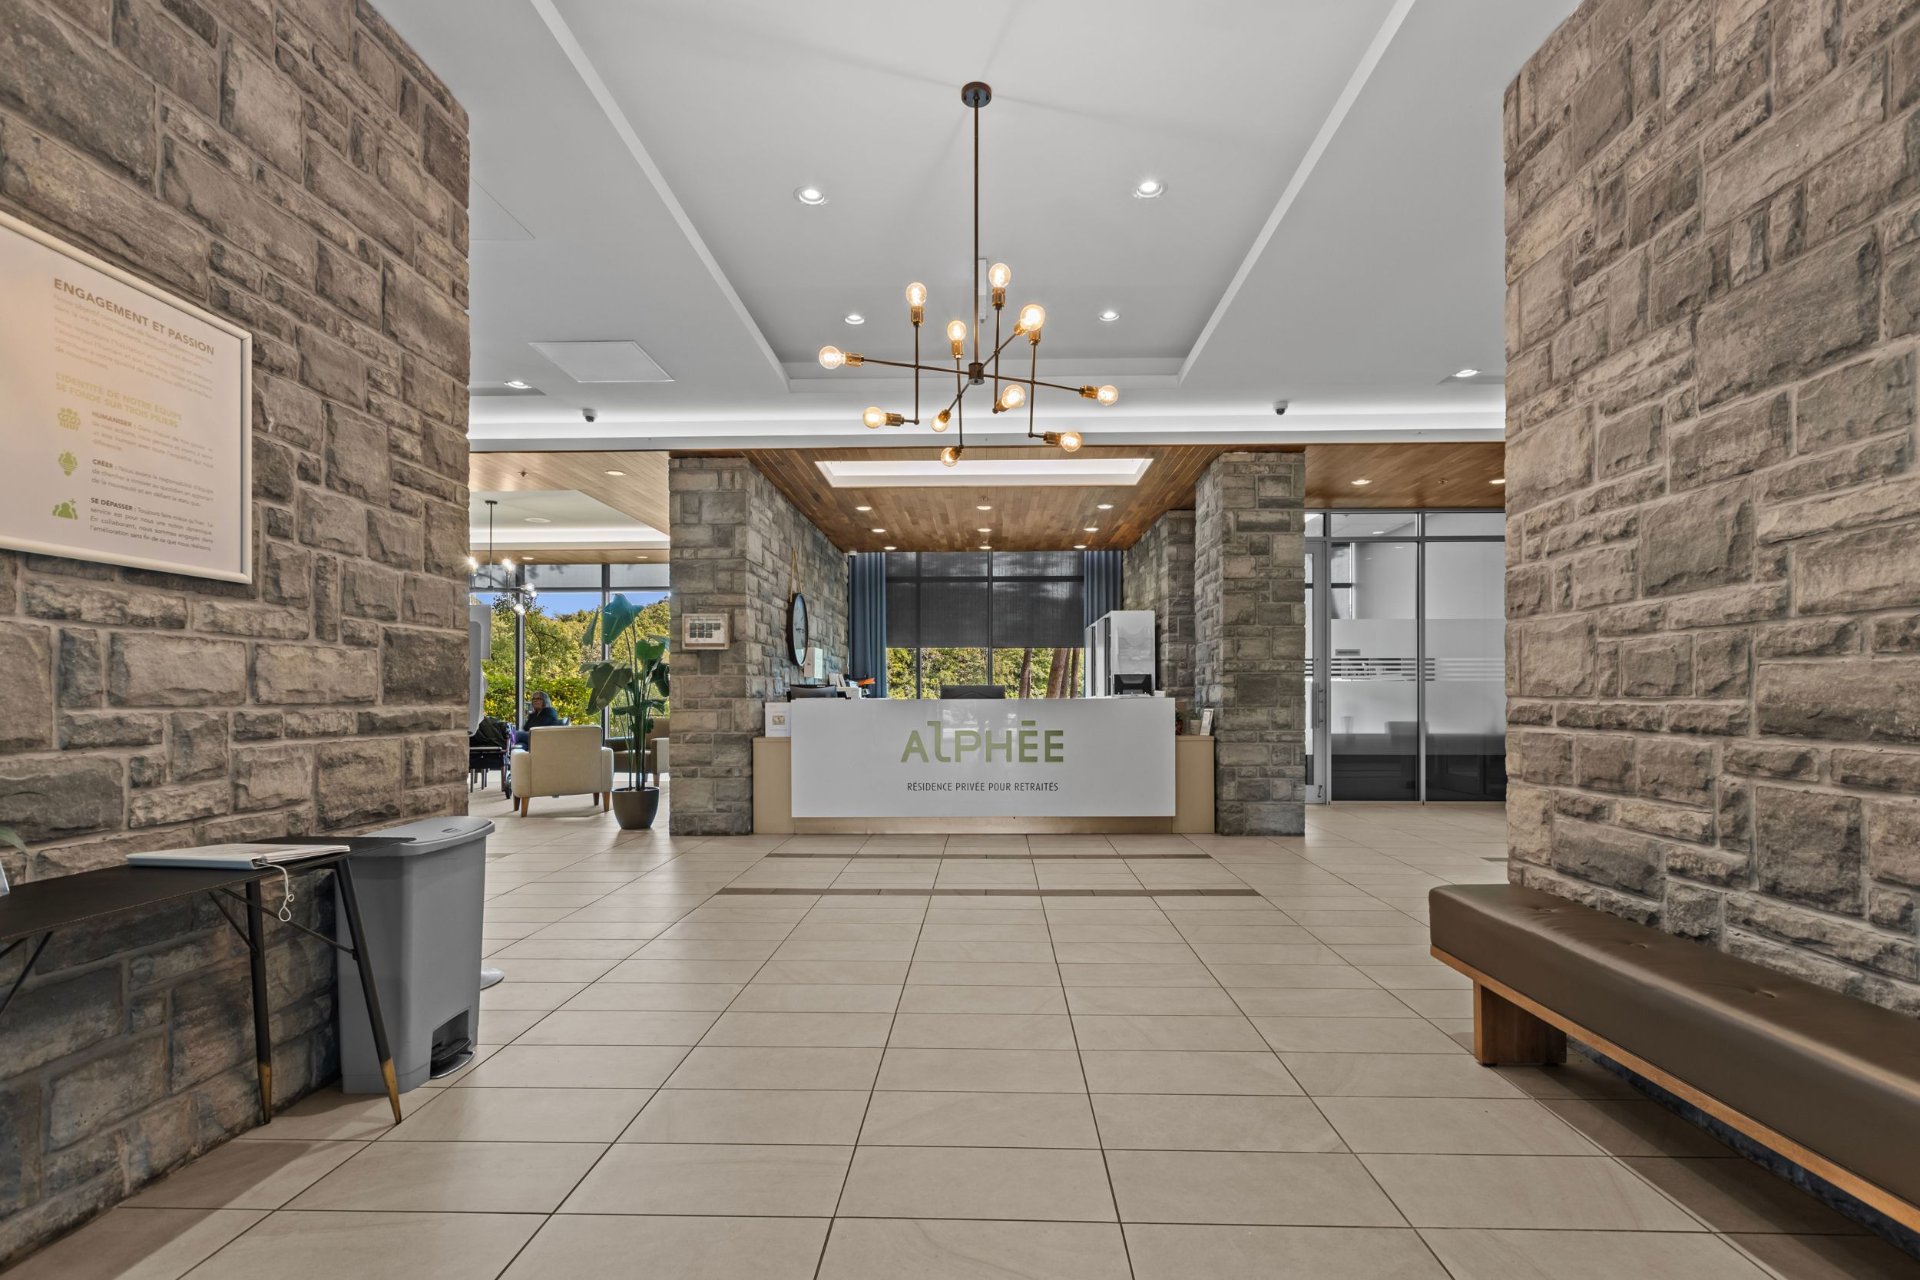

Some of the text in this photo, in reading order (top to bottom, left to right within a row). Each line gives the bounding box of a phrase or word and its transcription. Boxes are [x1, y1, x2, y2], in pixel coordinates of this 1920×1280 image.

[54, 278, 148, 327] ENGAGEMENT
[152, 321, 164, 334] ET
[168, 329, 214, 355] PASSION
[55, 383, 66, 393] SE
[105, 399, 121, 410] SUR
[125, 405, 147, 418] TROIS
[106, 389, 119, 400] DE
[91, 411, 131, 428] HUMANISER
[100, 499, 132, 511] DÉPASSER
[907, 781, 1059, 792] RÉSIDENCE PRIVÉE POUR RETRAITÉS
